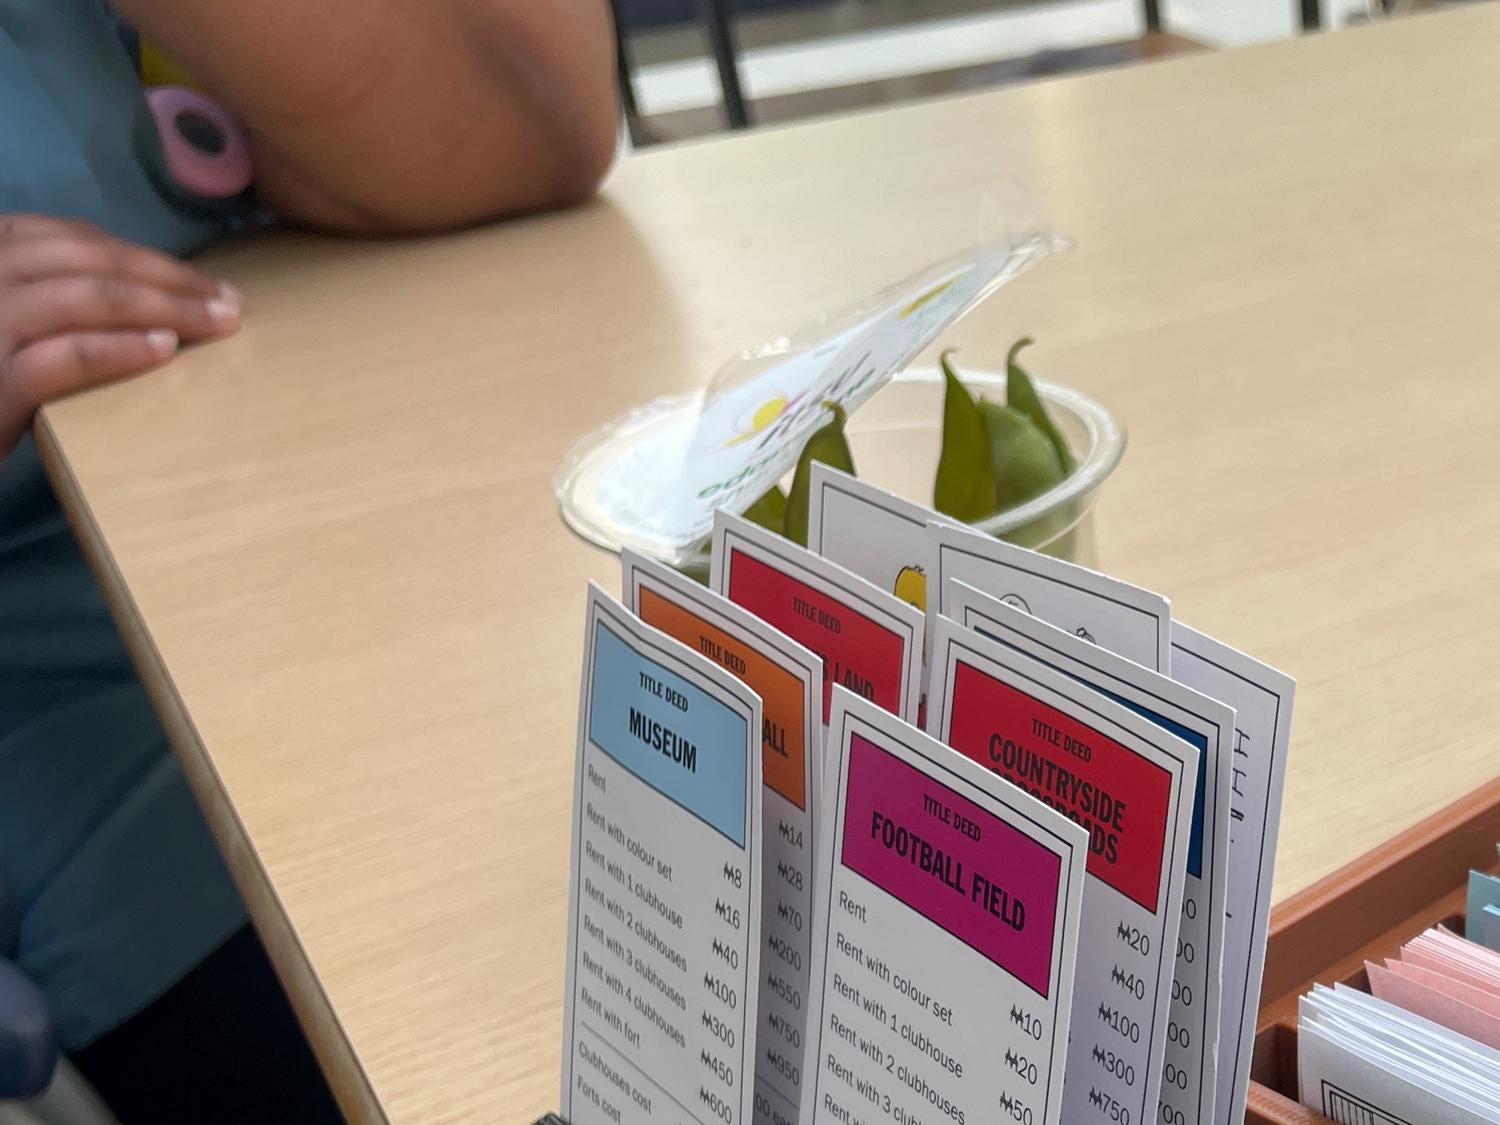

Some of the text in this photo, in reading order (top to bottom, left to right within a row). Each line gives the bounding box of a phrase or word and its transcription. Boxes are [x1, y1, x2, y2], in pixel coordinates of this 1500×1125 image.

[793, 596, 841, 634] TITLE DEED
[699, 635, 746, 676] TITLE DEED
[639, 671, 689, 713] TITLE DEED
[629, 707, 697, 774] MUSEUM
[1032, 718, 1092, 763] TITLE DEED
[587, 764, 607, 793] Rent
[989, 733, 1126, 833] COUNTRYSIDE
[587, 802, 606, 827] Rent
[607, 823, 625, 846] with
[626, 836, 655, 869] colour
[657, 860, 673, 883] set
[923, 794, 981, 843] TITLE DEED
[586, 840, 606, 865] Rent
[607, 860, 625, 885] with
[627, 875, 633, 891] 1
[635, 882, 683, 930] clubhouse
[839, 890, 867, 924] Rent
[871, 810, 966, 895] FOOTBALL
[971, 872, 1025, 932] FIELD
[585, 878, 605, 903] Rent
[606, 897, 625, 922] with
[626, 911, 633, 928] 2
[635, 919, 687, 973] clubhouses
[584, 914, 604, 940] Rent
[606, 935, 624, 960] with
[626, 949, 633, 966] 3
[634, 957, 686, 1011] clubhouses
[836, 932, 863, 965] Rent
[866, 957, 890, 983] with
[893, 974, 931, 1008] colour
[932, 1000, 953, 1027] set
[581, 987, 601, 1012] Rent
[604, 1004, 623, 1033] with
[625, 1022, 641, 1050] fort
[583, 950, 603, 977] Rent
[605, 972, 624, 997] with
[625, 987, 632, 1003] 4
[634, 995, 686, 1049] clubhouses
[833, 973, 862, 1005] Rent
[863, 996, 887, 1025] with
[890, 1014, 898, 1033] 1
[901, 1023, 963, 1079] clubhouse
[577, 1074, 600, 1108] Forts
[601, 1098, 622, 1125] cost
[578, 1039, 631, 1096] Clubhouses
[632, 1087, 652, 1116] cost
[827, 1053, 853, 1087] Rent
[856, 1077, 880, 1107] with
[882, 1095, 891, 1114] 3
[830, 1014, 857, 1048] Rent
[860, 1036, 883, 1066] with
[886, 1054, 895, 1074] 2
[897, 1063, 965, 1125] clubhouses
